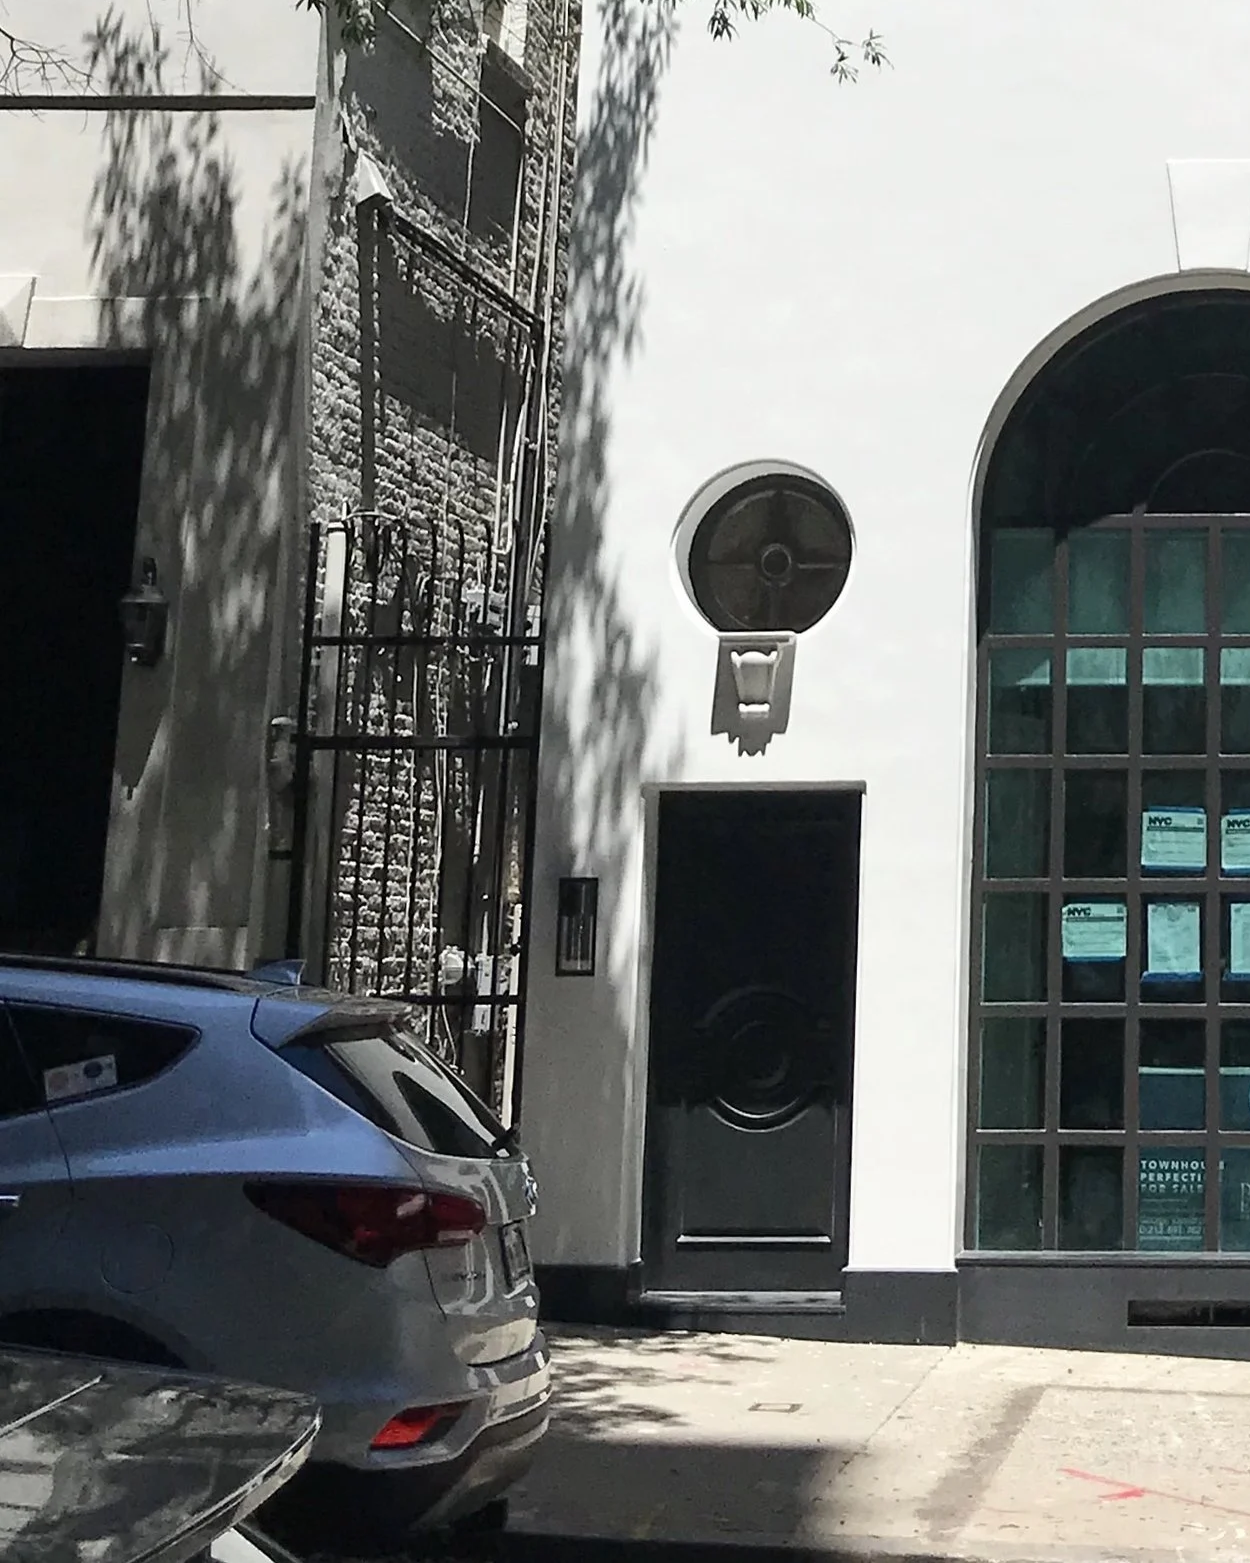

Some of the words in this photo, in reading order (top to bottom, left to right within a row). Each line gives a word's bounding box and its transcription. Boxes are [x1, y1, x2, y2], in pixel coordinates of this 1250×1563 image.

[1149, 816, 1172, 825] NYC
[1226, 819, 1250, 828] NYC
[1140, 1160, 1224, 1170] TOWNHOUE
[1140, 1184, 1166, 1194] FOR
[1172, 1184, 1204, 1194] SALE
